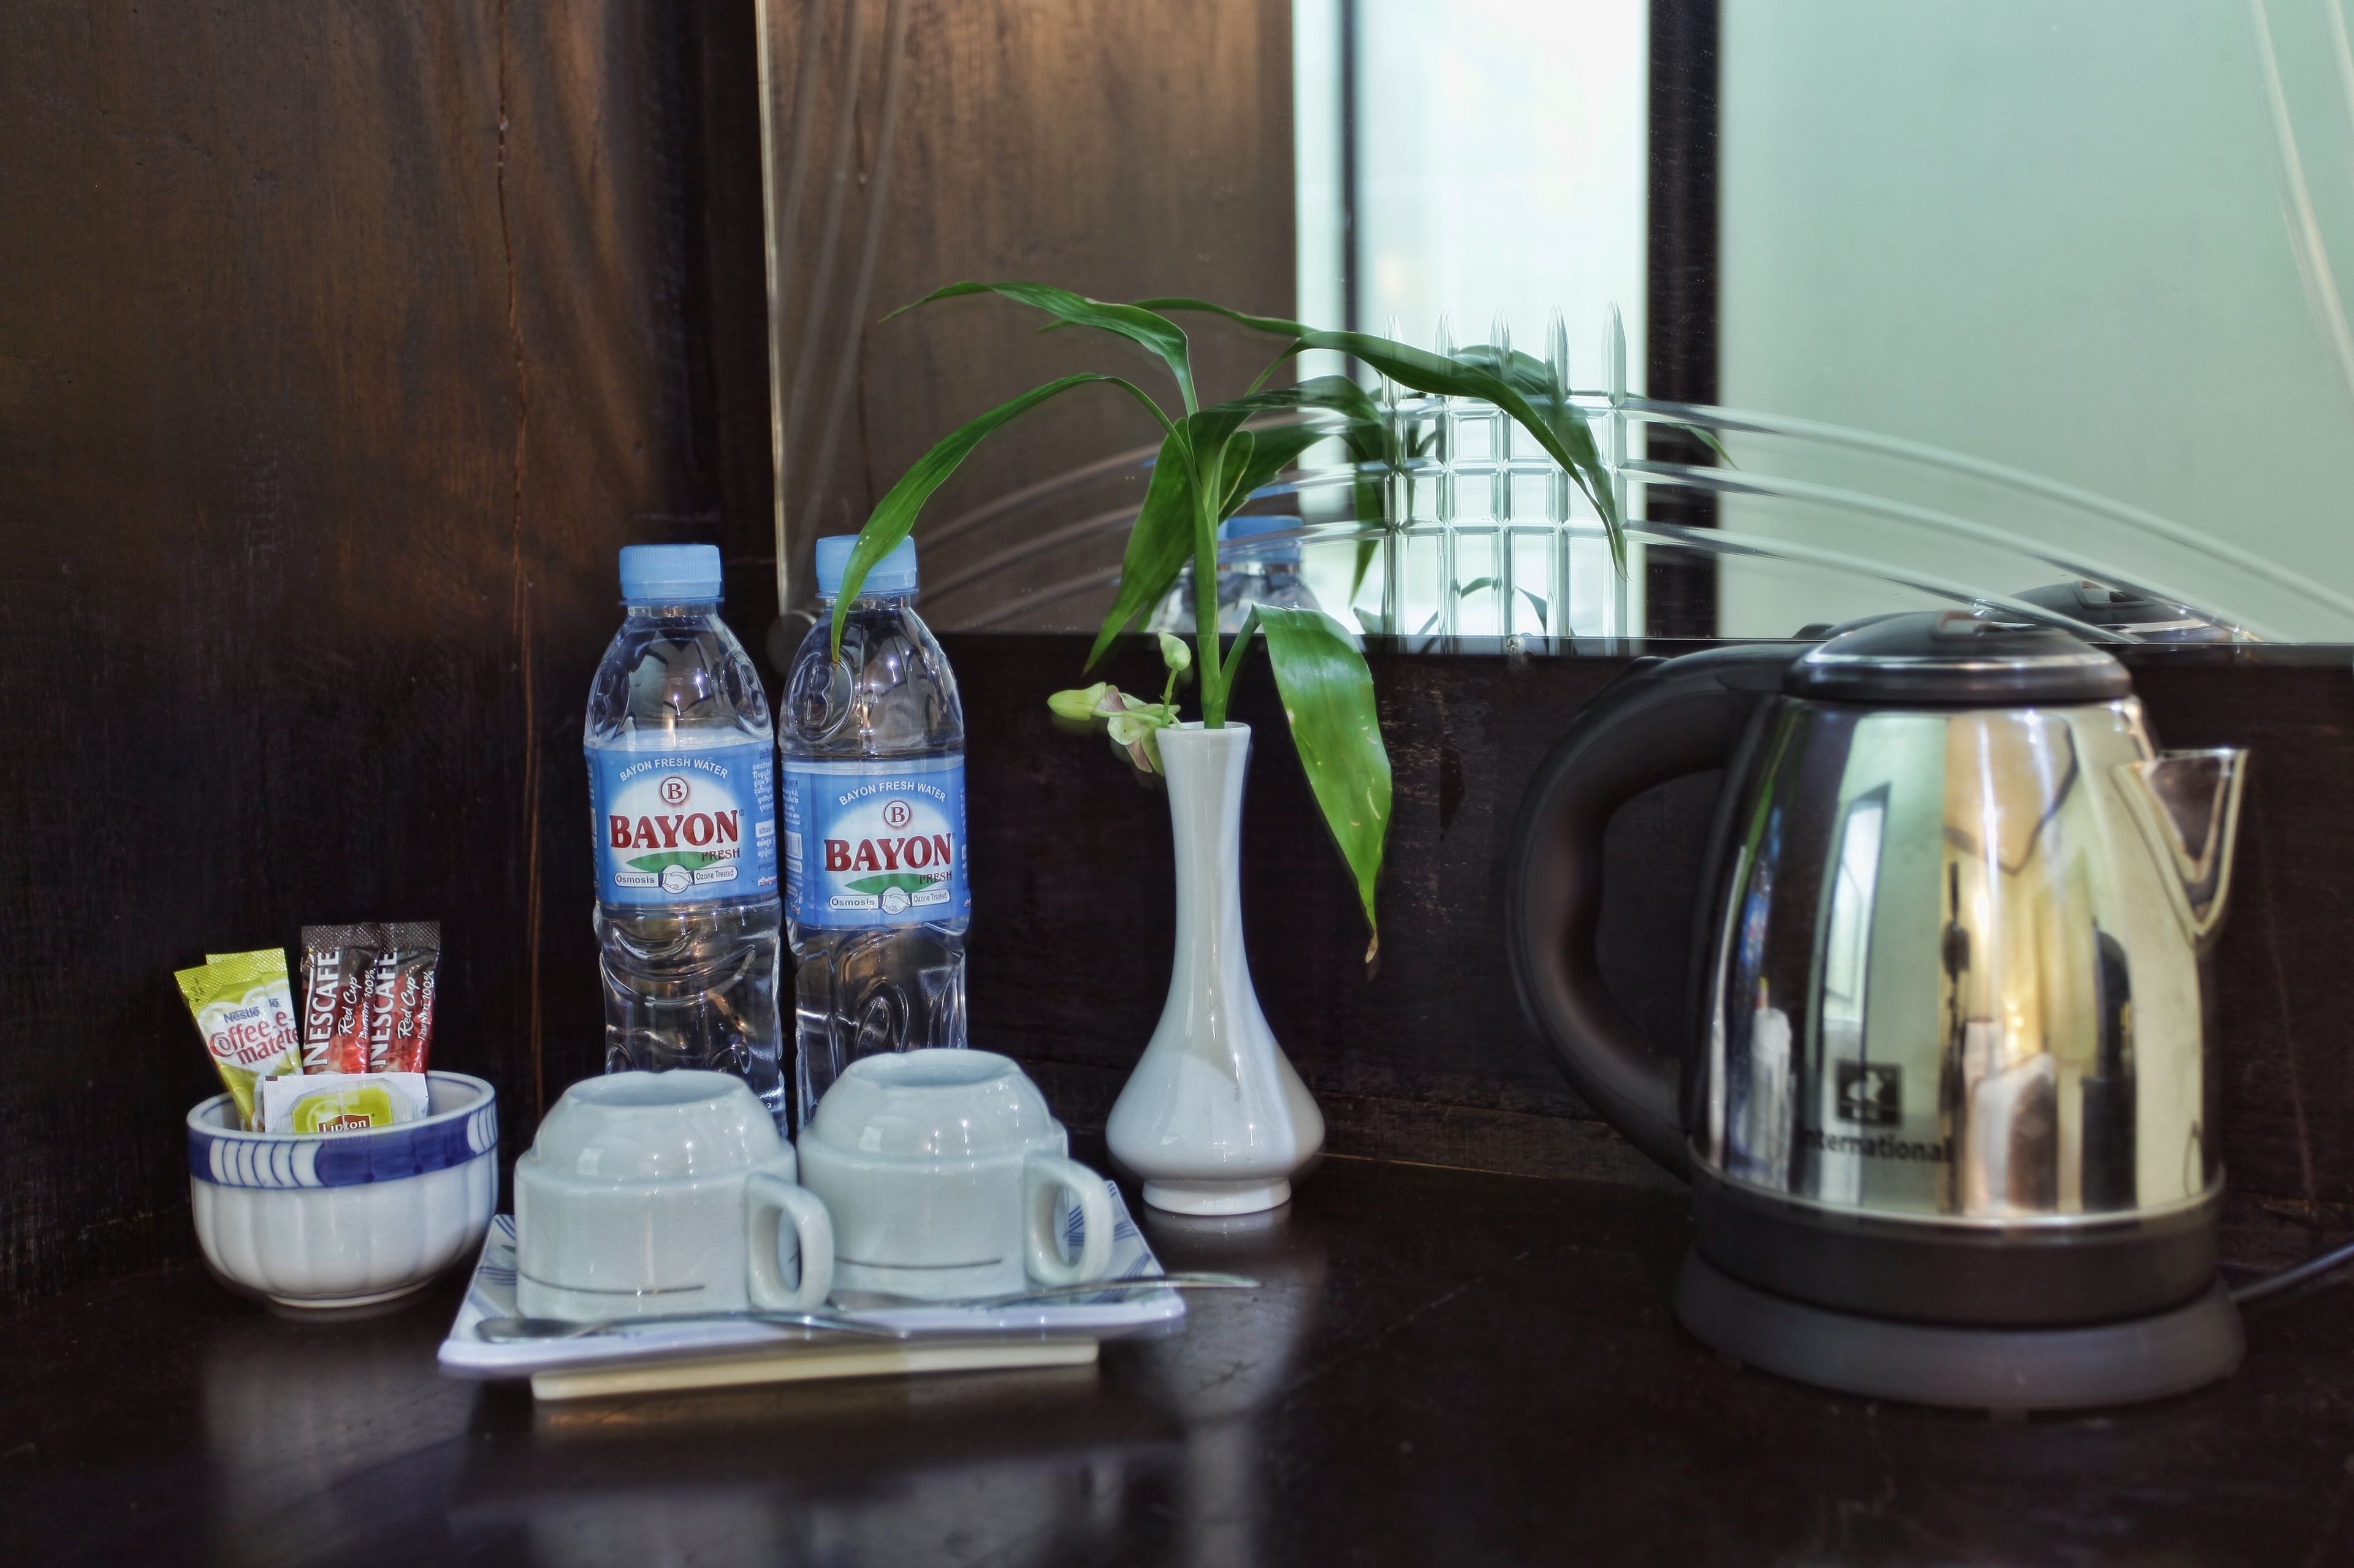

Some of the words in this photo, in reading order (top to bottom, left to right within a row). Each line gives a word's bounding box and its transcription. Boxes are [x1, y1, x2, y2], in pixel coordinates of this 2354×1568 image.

[620, 761, 652, 782] BAYON
[655, 758, 691, 767] FRESH
[694, 759, 728, 778] WATER
[667, 783, 683, 799] B
[839, 785, 876, 805] BAYON
[879, 781, 914, 792] FRESH
[917, 783, 945, 802] WATER
[890, 807, 905, 823] B
[609, 810, 738, 849] BAYON
[701, 848, 741, 862] FRESH
[823, 833, 951, 872] BAYON
[616, 875, 655, 883] Osmosis
[715, 870, 734, 878] Treated
[919, 871, 952, 885] FRESH
[831, 897, 875, 906] Osmosis
[931, 892, 947, 900] Treated
[343, 976, 362, 1005] Cup
[401, 976, 421, 1007] Cup
[422, 970, 435, 1000] 100%
[338, 1007, 356, 1037] Red
[398, 1008, 414, 1039] Red
[236, 1034, 286, 1065] mate
[1797, 1128, 1954, 1163] nternational
